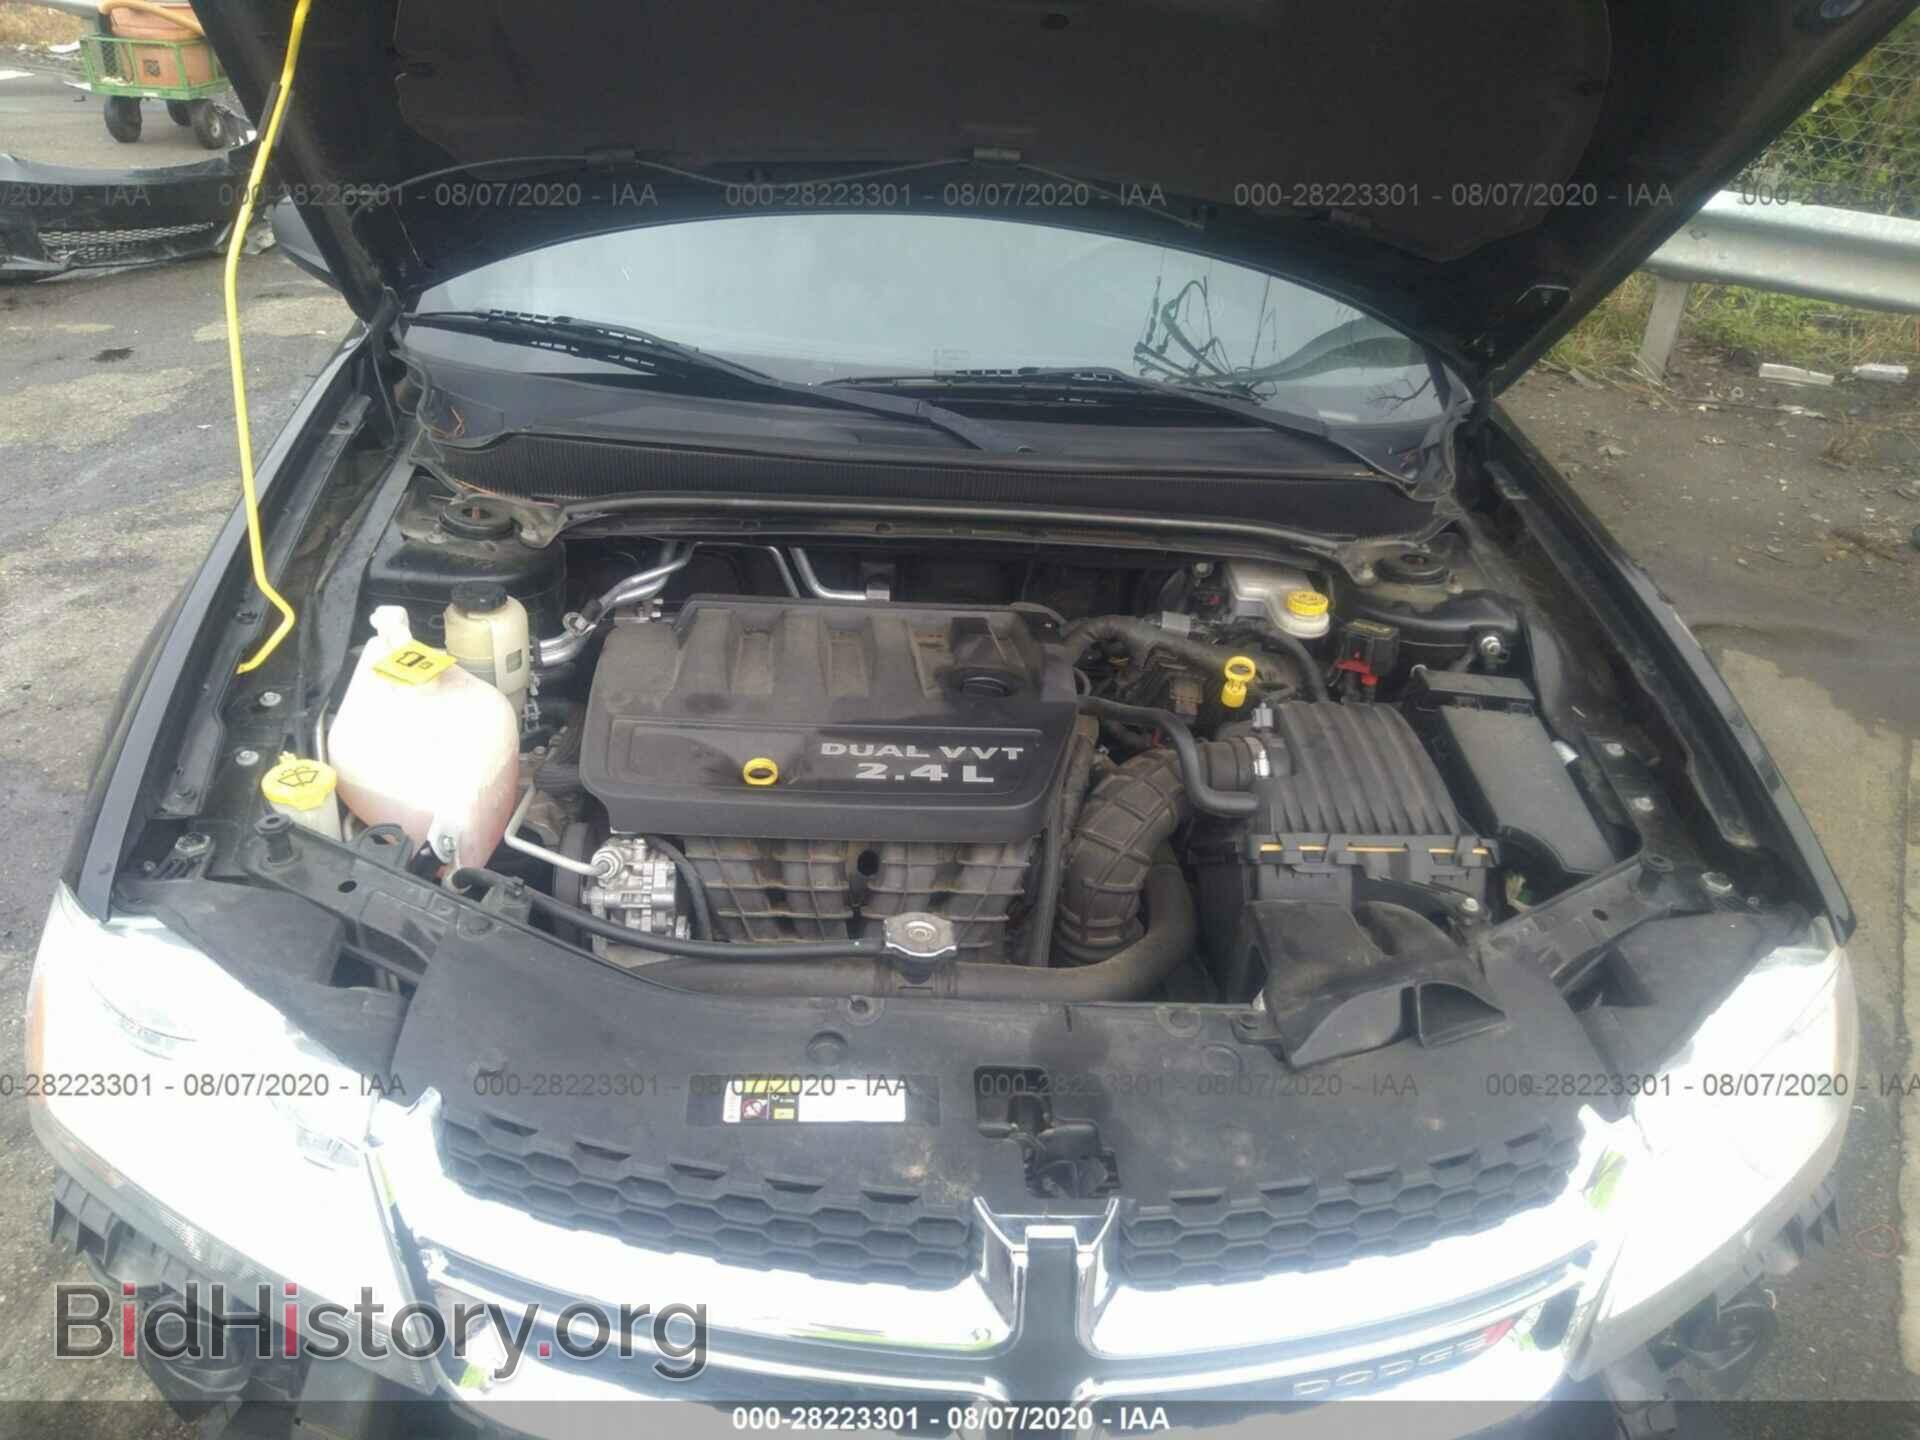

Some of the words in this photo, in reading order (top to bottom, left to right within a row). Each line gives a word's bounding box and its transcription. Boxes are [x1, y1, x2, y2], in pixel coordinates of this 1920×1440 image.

[820, 742, 931, 759] DUAL
[938, 746, 1025, 760] VVT
[855, 762, 949, 782] 2.4
[962, 765, 995, 783] L
[1292, 1334, 1488, 1396] DODGE
